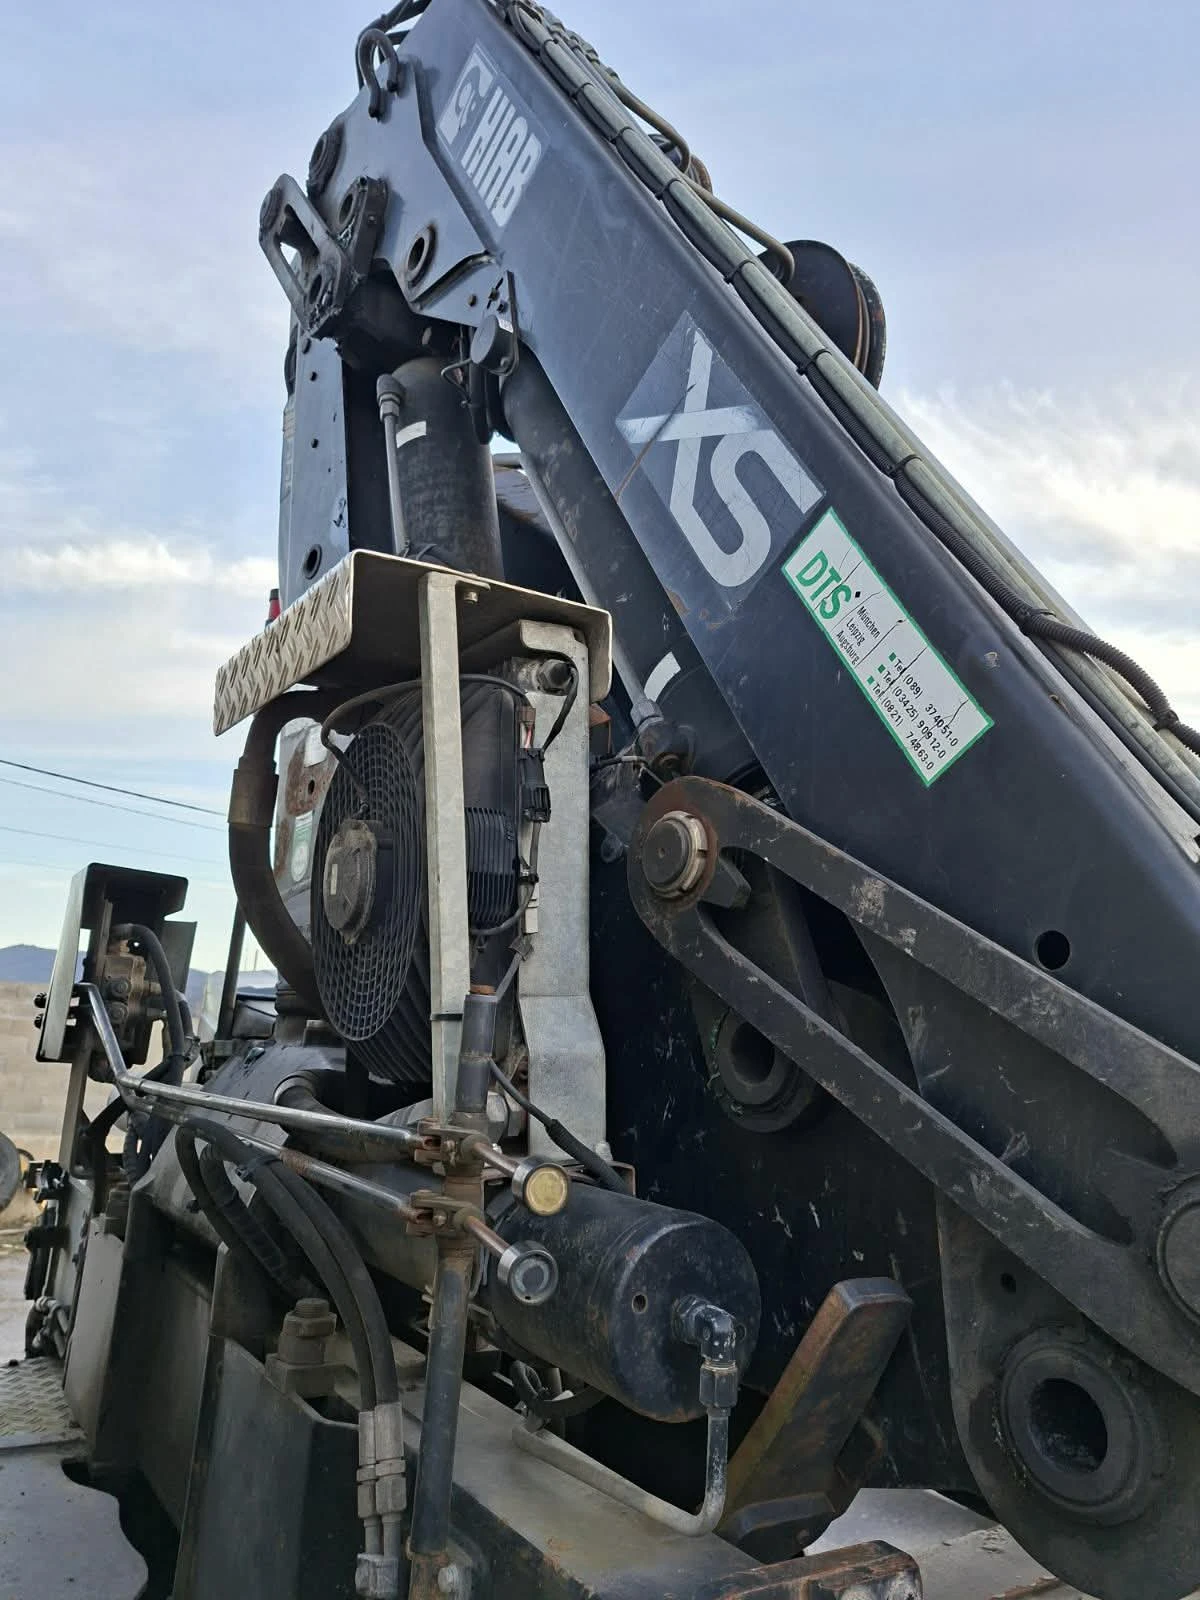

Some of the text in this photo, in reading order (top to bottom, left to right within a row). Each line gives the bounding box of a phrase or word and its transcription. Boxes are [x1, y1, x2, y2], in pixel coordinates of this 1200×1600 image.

[461, 85, 541, 227] HIAB
[616, 330, 824, 587] XS
[795, 550, 851, 619] DTS
[836, 630, 860, 665] Augsburg
[846, 617, 865, 647] Leipzig
[857, 605, 880, 639] München
[903, 674, 923, 699] (089)
